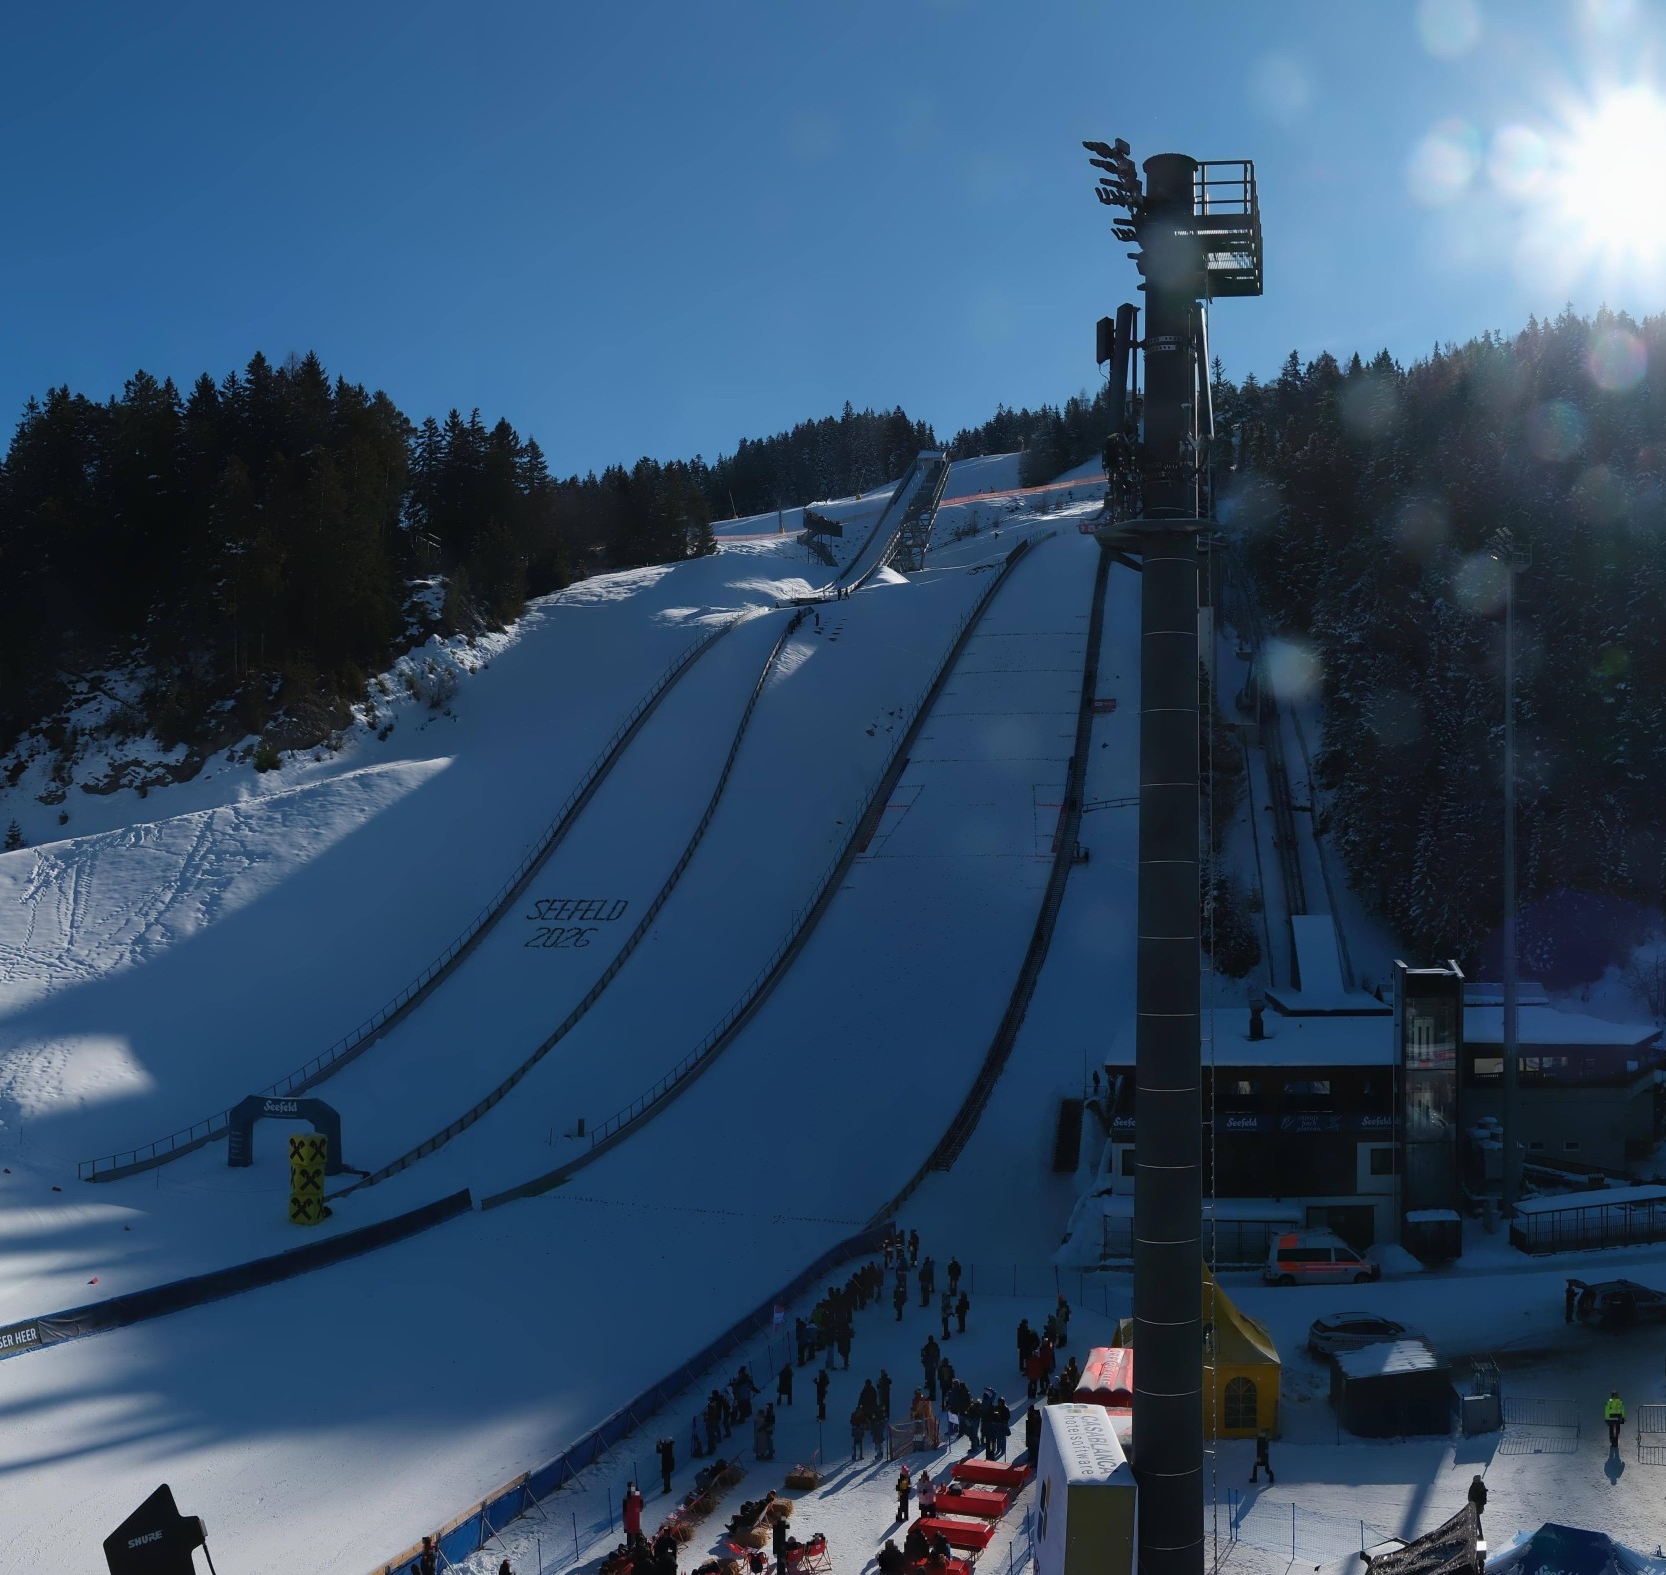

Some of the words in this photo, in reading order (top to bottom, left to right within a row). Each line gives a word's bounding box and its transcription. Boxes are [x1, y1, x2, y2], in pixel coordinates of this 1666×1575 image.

[526, 899, 629, 921] SEEFELD
[524, 927, 599, 948] 2026
[264, 1100, 298, 1112] Seefeld
[1113, 1117, 1136, 1128] Seefe
[1226, 1117, 1258, 1129] Seefeld
[15, 1328, 37, 1344] HEER
[1065, 1415, 1094, 1476] hotelsoftware
[1081, 1415, 1117, 1475] CASABLANCA
[128, 1530, 163, 1549] SHURE
